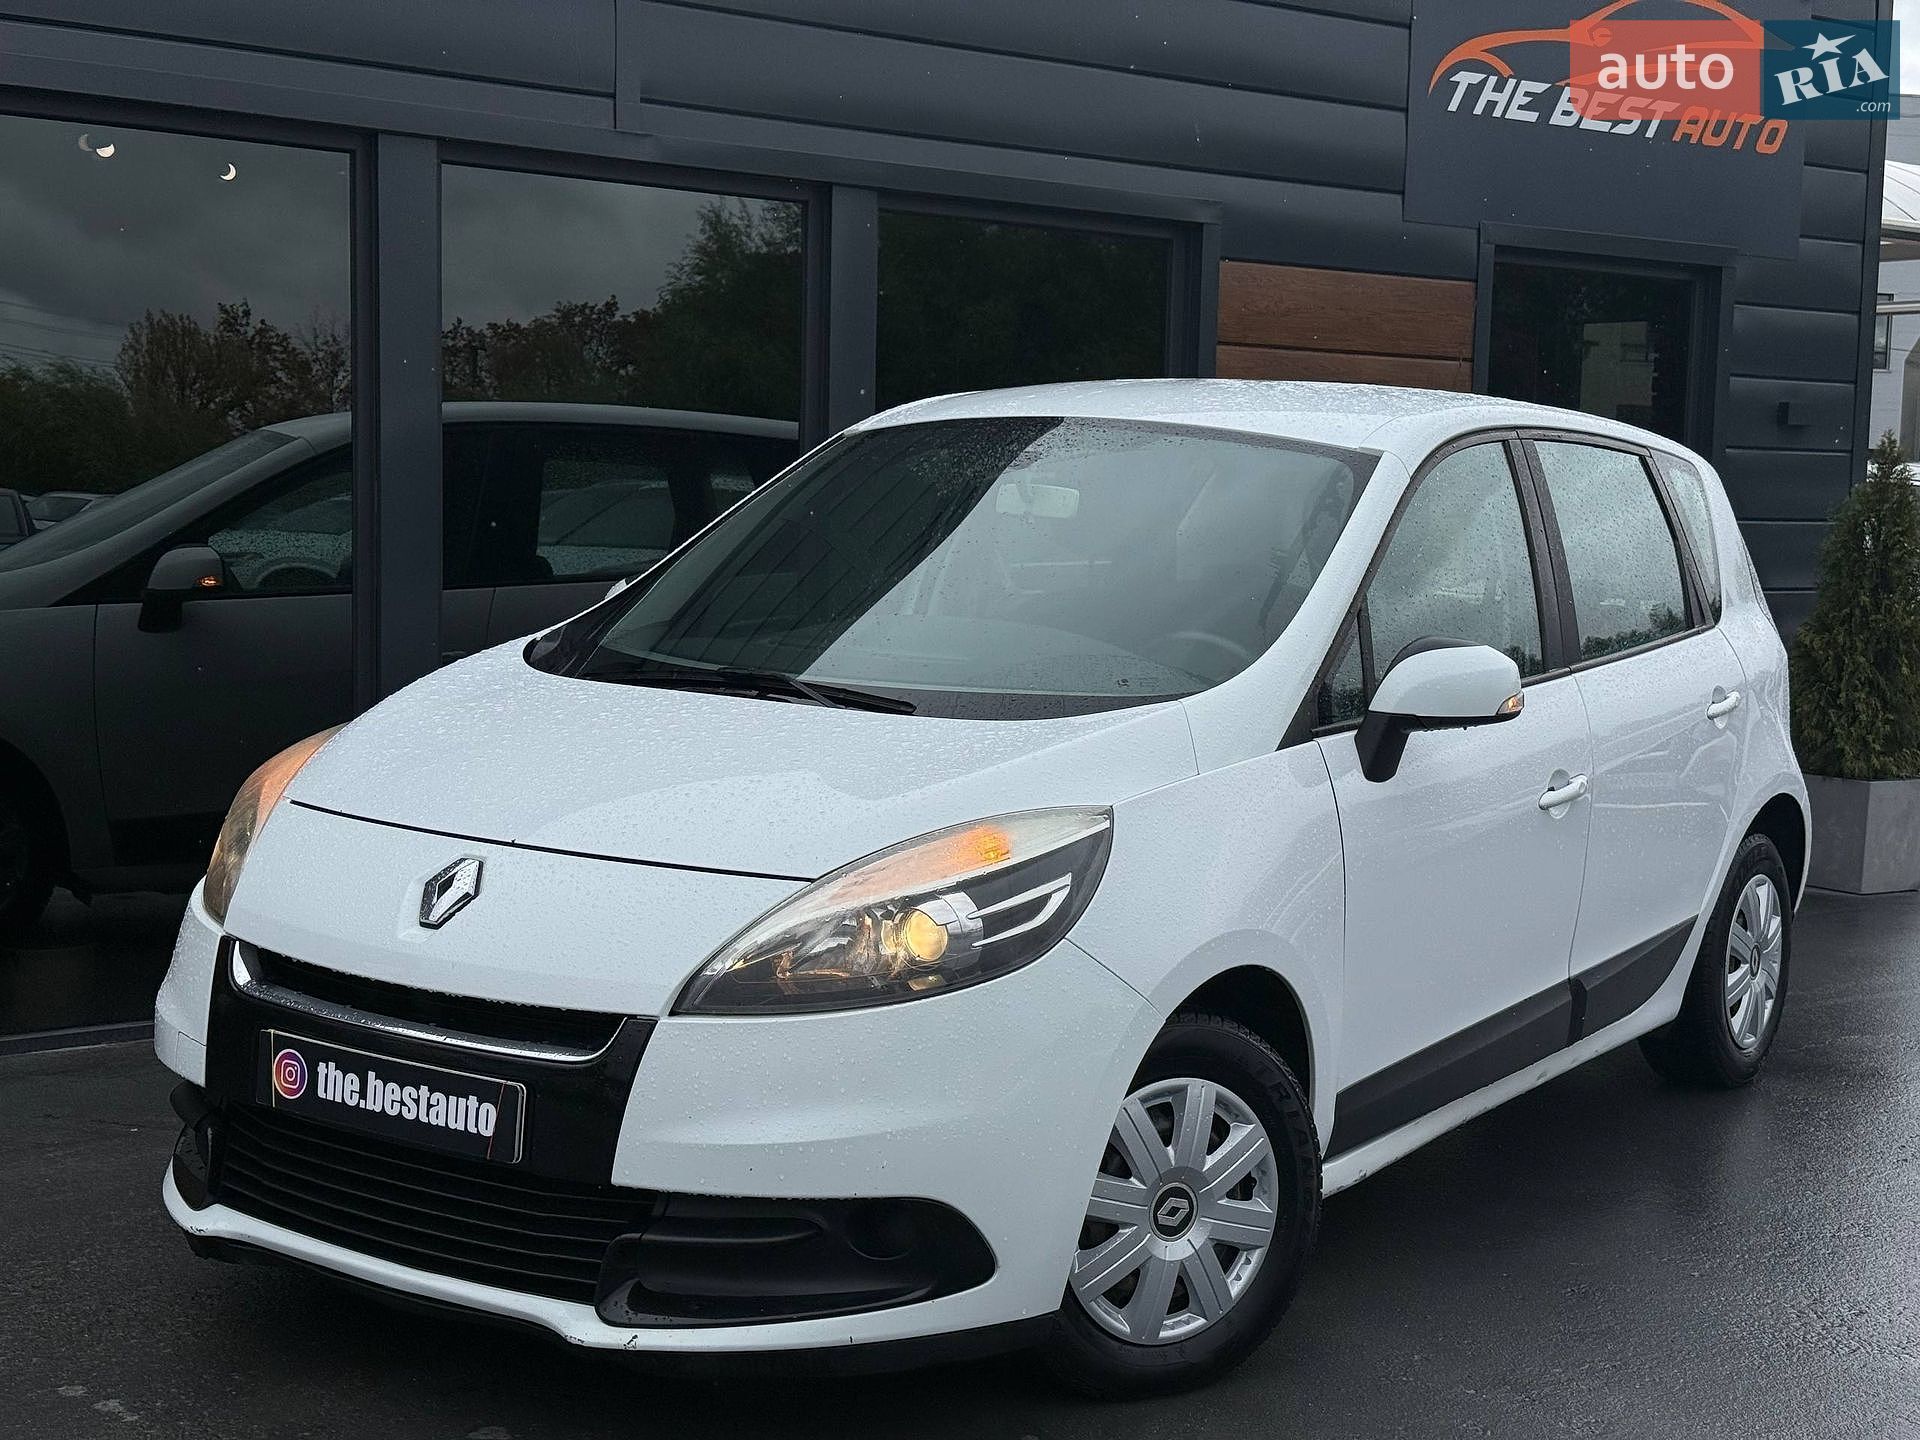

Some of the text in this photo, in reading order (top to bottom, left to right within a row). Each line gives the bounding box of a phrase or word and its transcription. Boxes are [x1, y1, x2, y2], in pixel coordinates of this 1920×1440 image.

[1447, 71, 1789, 154] THE BEST AUTO
[316, 1061, 497, 1137] the.bestauto
